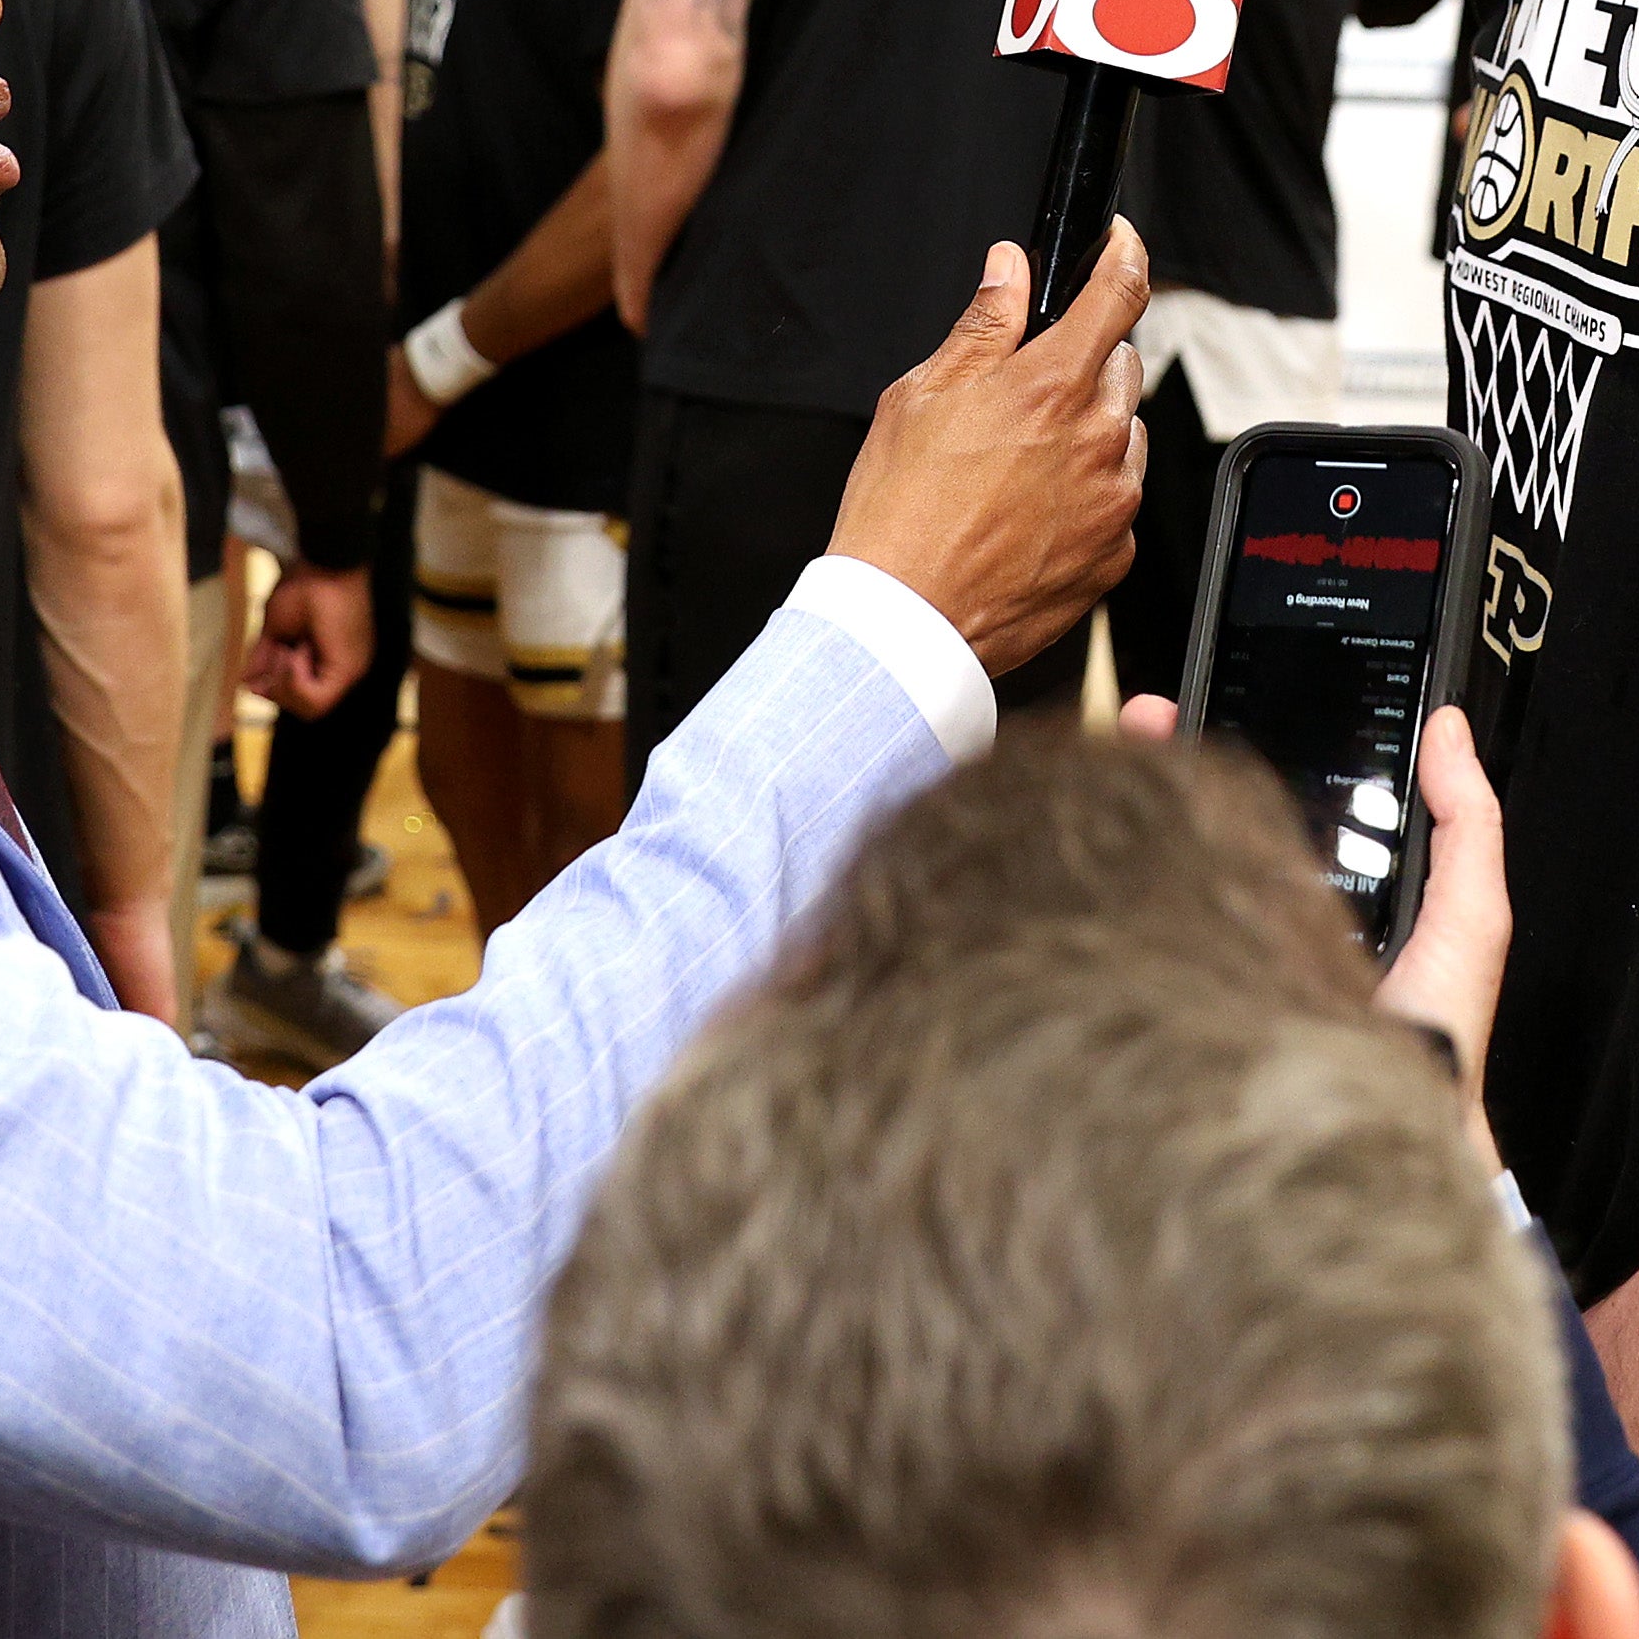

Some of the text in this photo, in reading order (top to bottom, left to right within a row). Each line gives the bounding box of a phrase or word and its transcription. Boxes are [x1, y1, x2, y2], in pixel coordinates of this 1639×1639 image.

[1512, 279, 1561, 320] REGIONAL
[1564, 304, 1607, 343] CHAMPS
[1295, 592, 1346, 610] Recording
[1347, 598, 1370, 611] New
[1357, 875, 1379, 894] All
